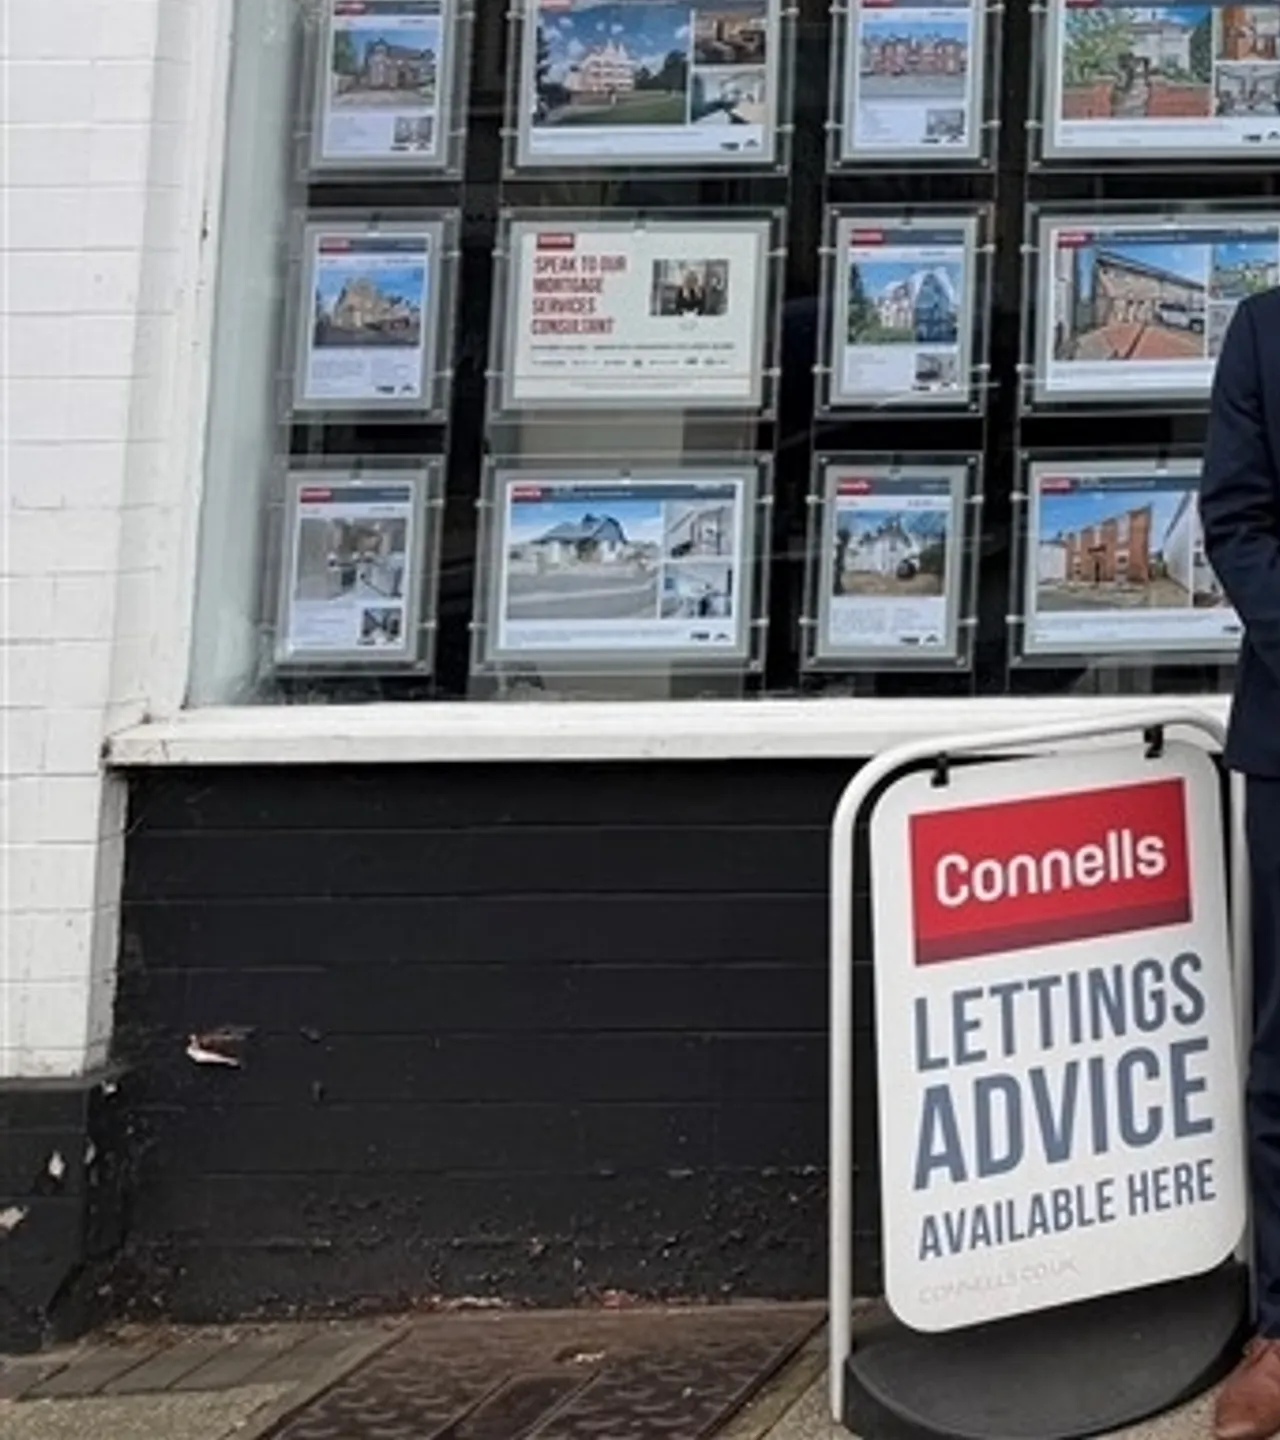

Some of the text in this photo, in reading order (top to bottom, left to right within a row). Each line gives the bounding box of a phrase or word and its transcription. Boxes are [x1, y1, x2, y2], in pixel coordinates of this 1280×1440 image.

[532, 277, 603, 293] MORTGAGE
[534, 255, 627, 274] SPEAK TO OUR
[530, 318, 614, 335] CONSULTANT
[531, 297, 597, 314] SERVICES
[936, 828, 1166, 907] Connells
[915, 952, 1205, 1072] LETTINGS
[913, 1037, 1214, 1191] ADVICE
[919, 1159, 1216, 1260] AVAILABLE HERE
